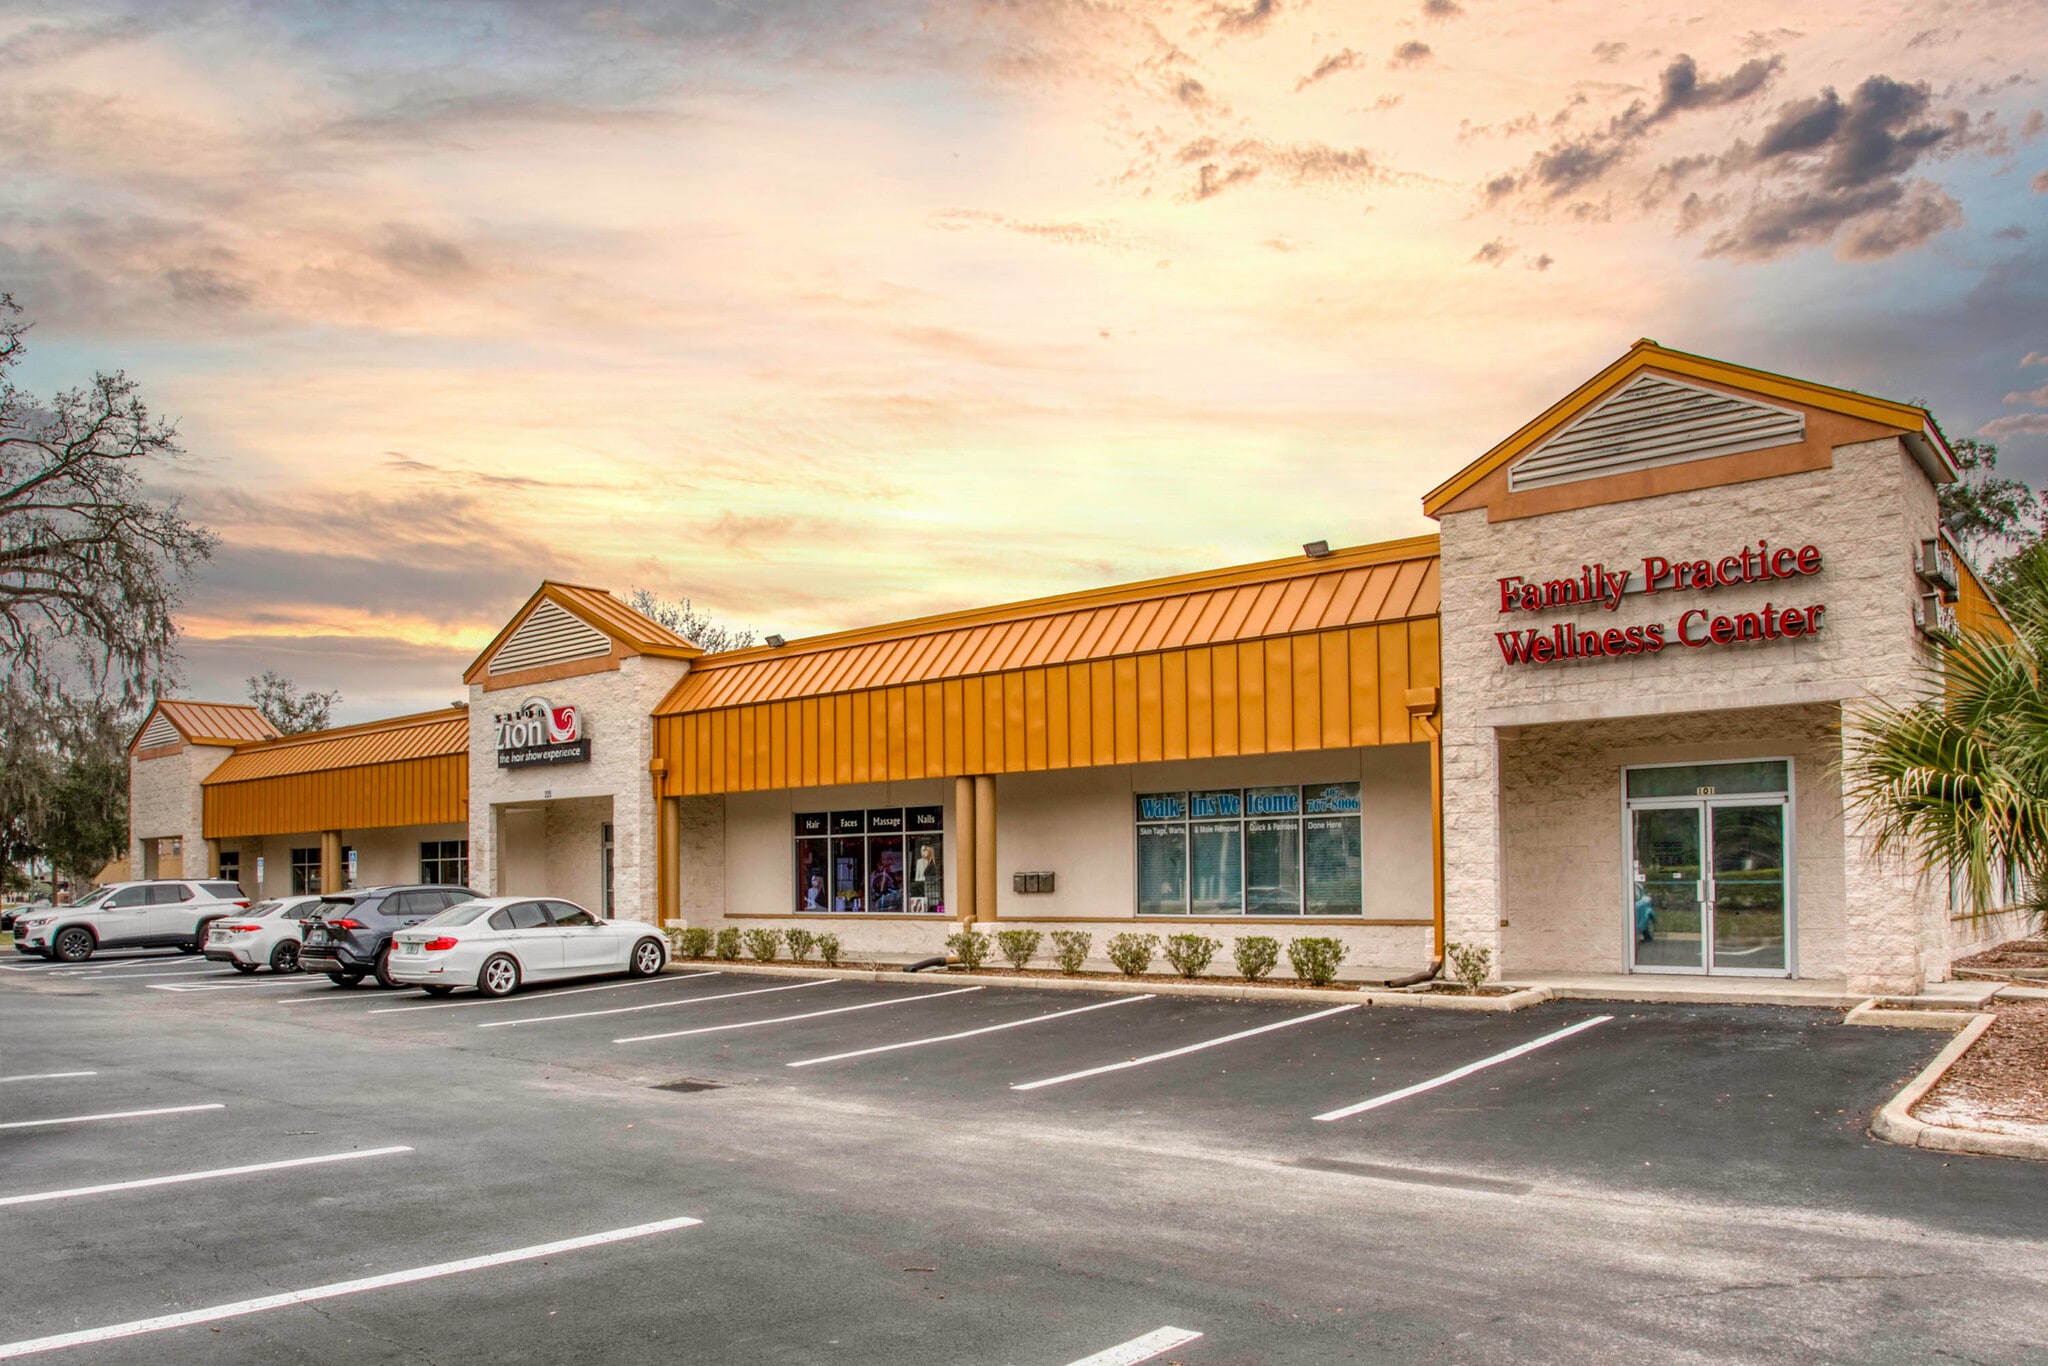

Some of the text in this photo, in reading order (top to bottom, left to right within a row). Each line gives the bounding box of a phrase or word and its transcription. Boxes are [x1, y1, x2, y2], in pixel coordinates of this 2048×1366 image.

[1497, 539, 1823, 613] Family Practice
[1495, 601, 1826, 666] Wellness Center
[511, 751, 525, 763] hair
[525, 749, 543, 761] show
[543, 746, 581, 761] experience
[840, 818, 858, 828] Faces
[873, 816, 901, 827] Massage
[917, 814, 936, 824] Nails
[806, 820, 820, 829] Hair
[1214, 824, 1239, 833] Removal
[1249, 821, 1266, 833] Quick
[1273, 822, 1298, 831] Painless
[1308, 820, 1343, 829] Done Here
[1140, 827, 1153, 835] Skin
